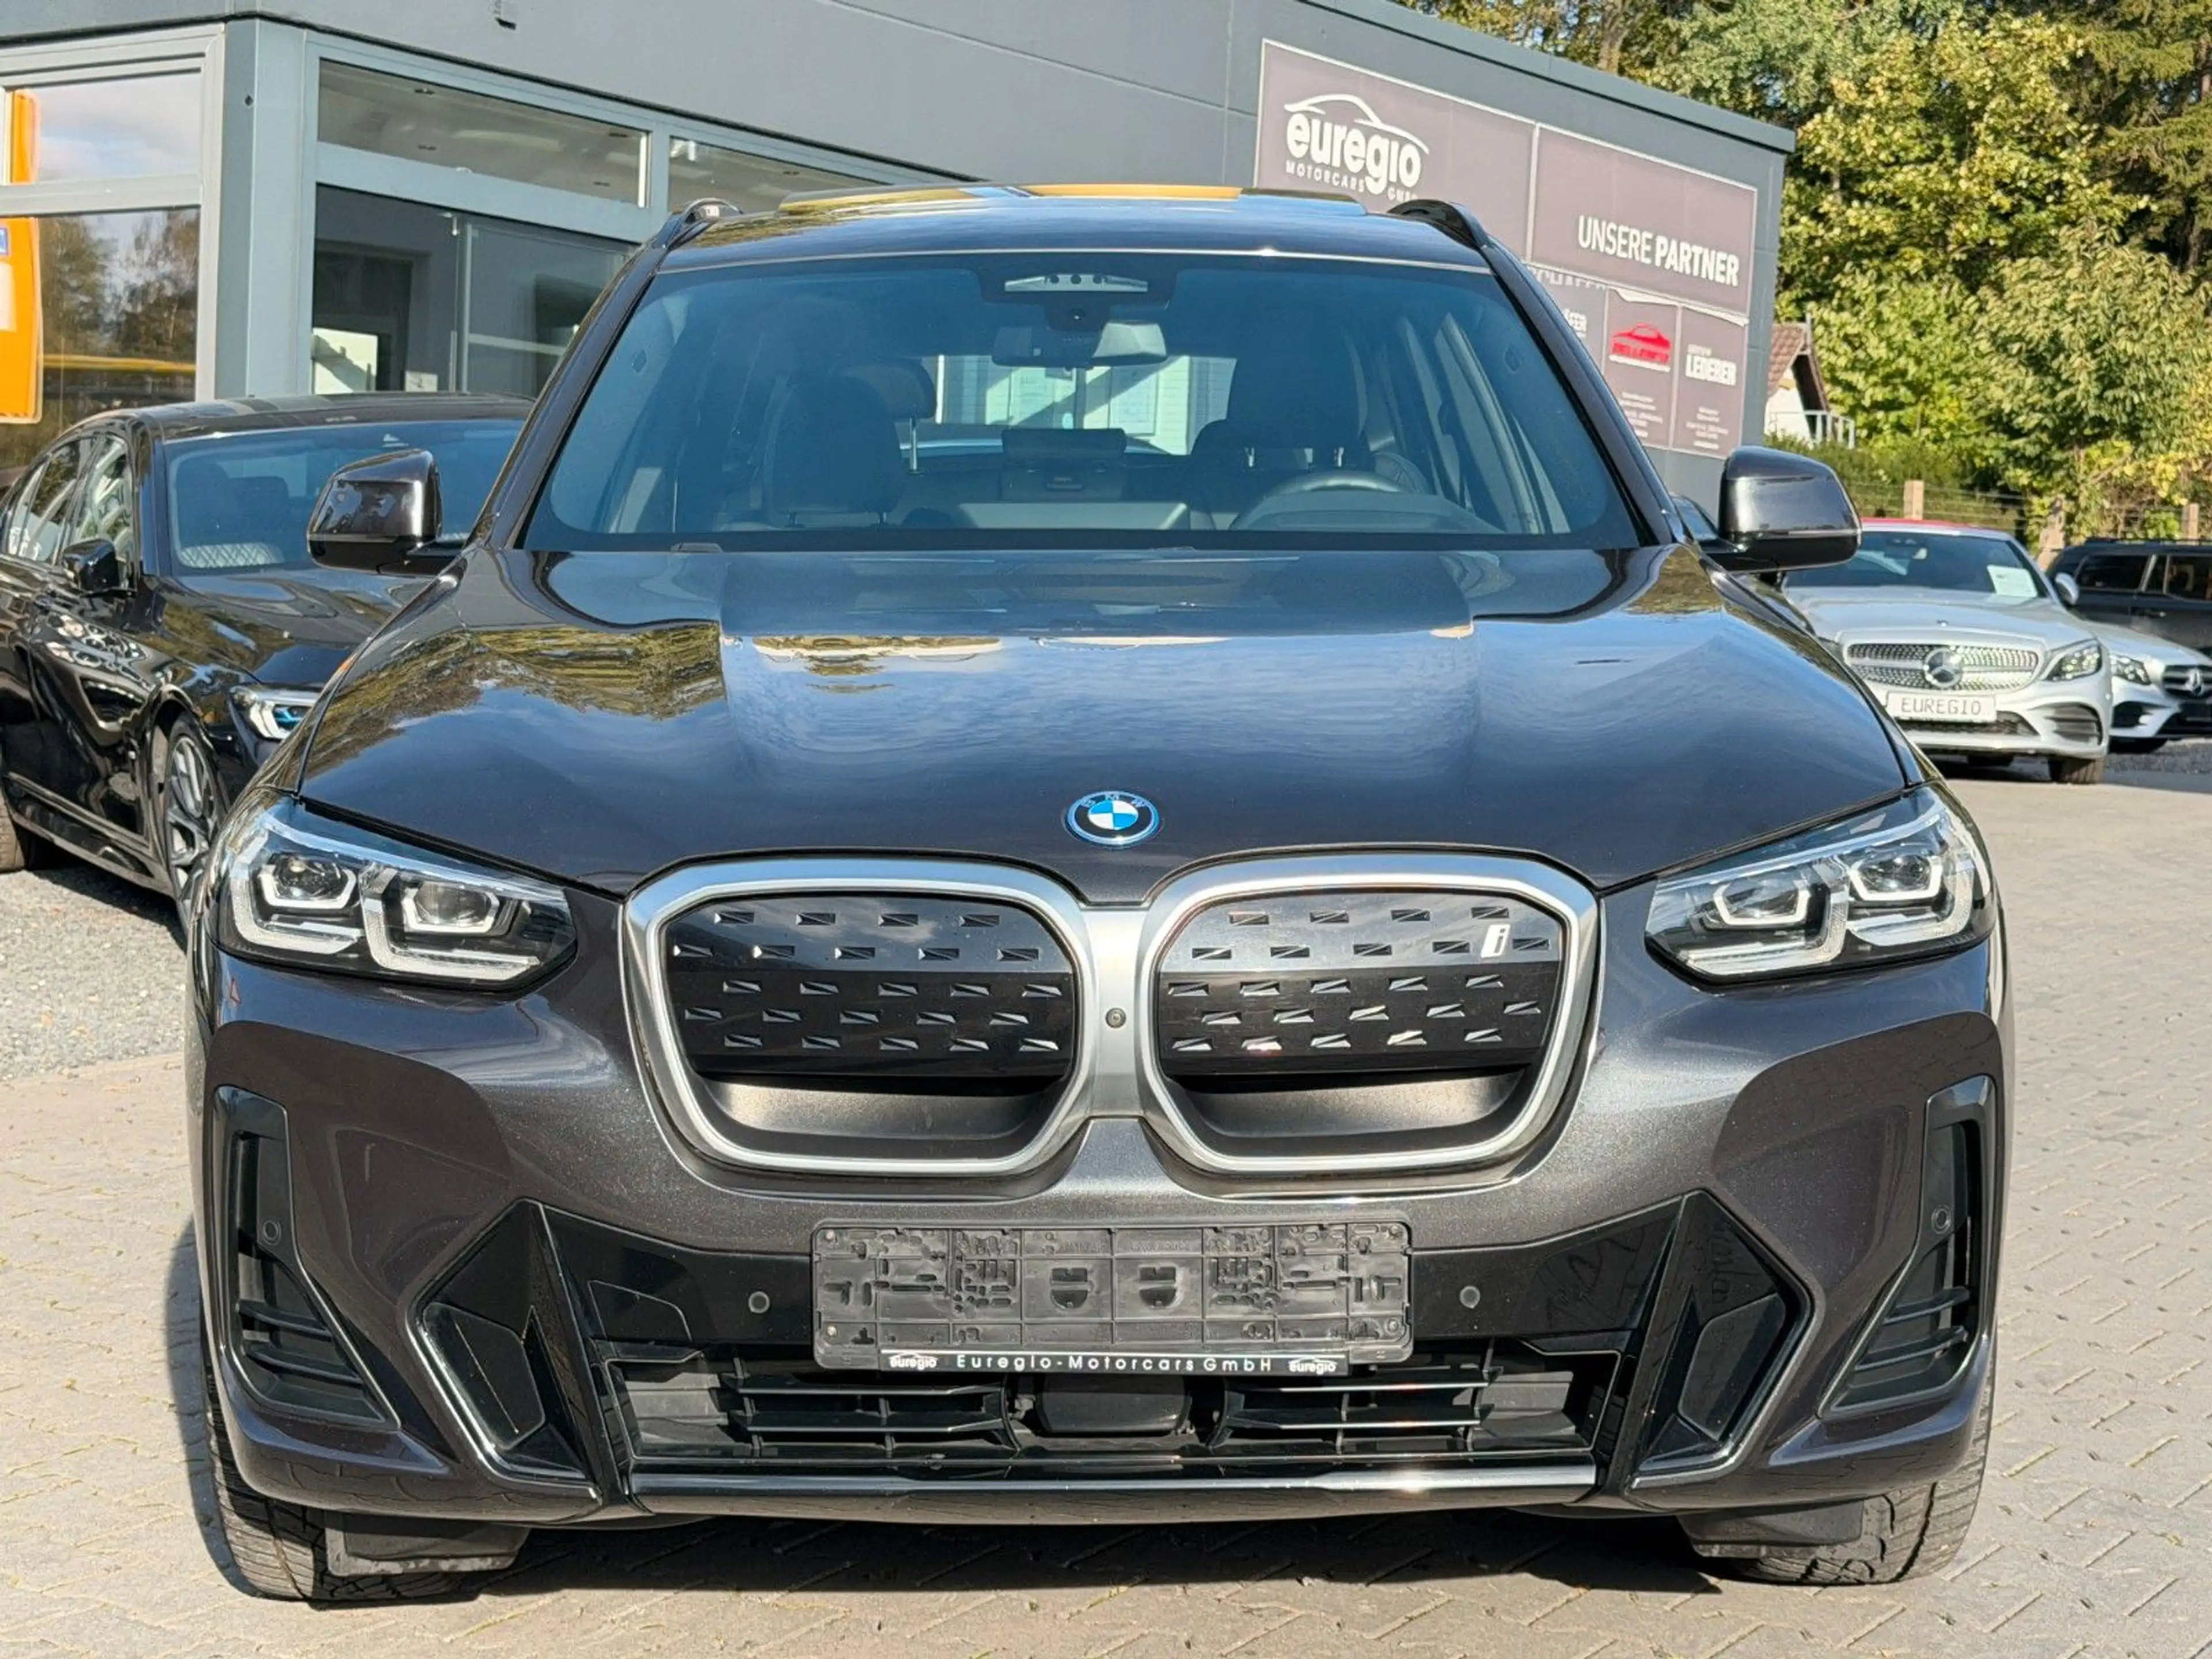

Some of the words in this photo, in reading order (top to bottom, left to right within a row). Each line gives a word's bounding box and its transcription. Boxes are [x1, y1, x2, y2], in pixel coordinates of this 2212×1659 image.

[1287, 113, 1421, 195] euregio
[1286, 160, 1365, 193] MOTORCARS
[1578, 215, 1653, 264] UNSERE
[1654, 234, 1739, 287] PARTNER
[1901, 697, 1982, 715] EUREGIO
[889, 1355, 938, 1370] euregio
[1203, 1357, 1271, 1372] GmbH
[1288, 1358, 1338, 1375] euregio
